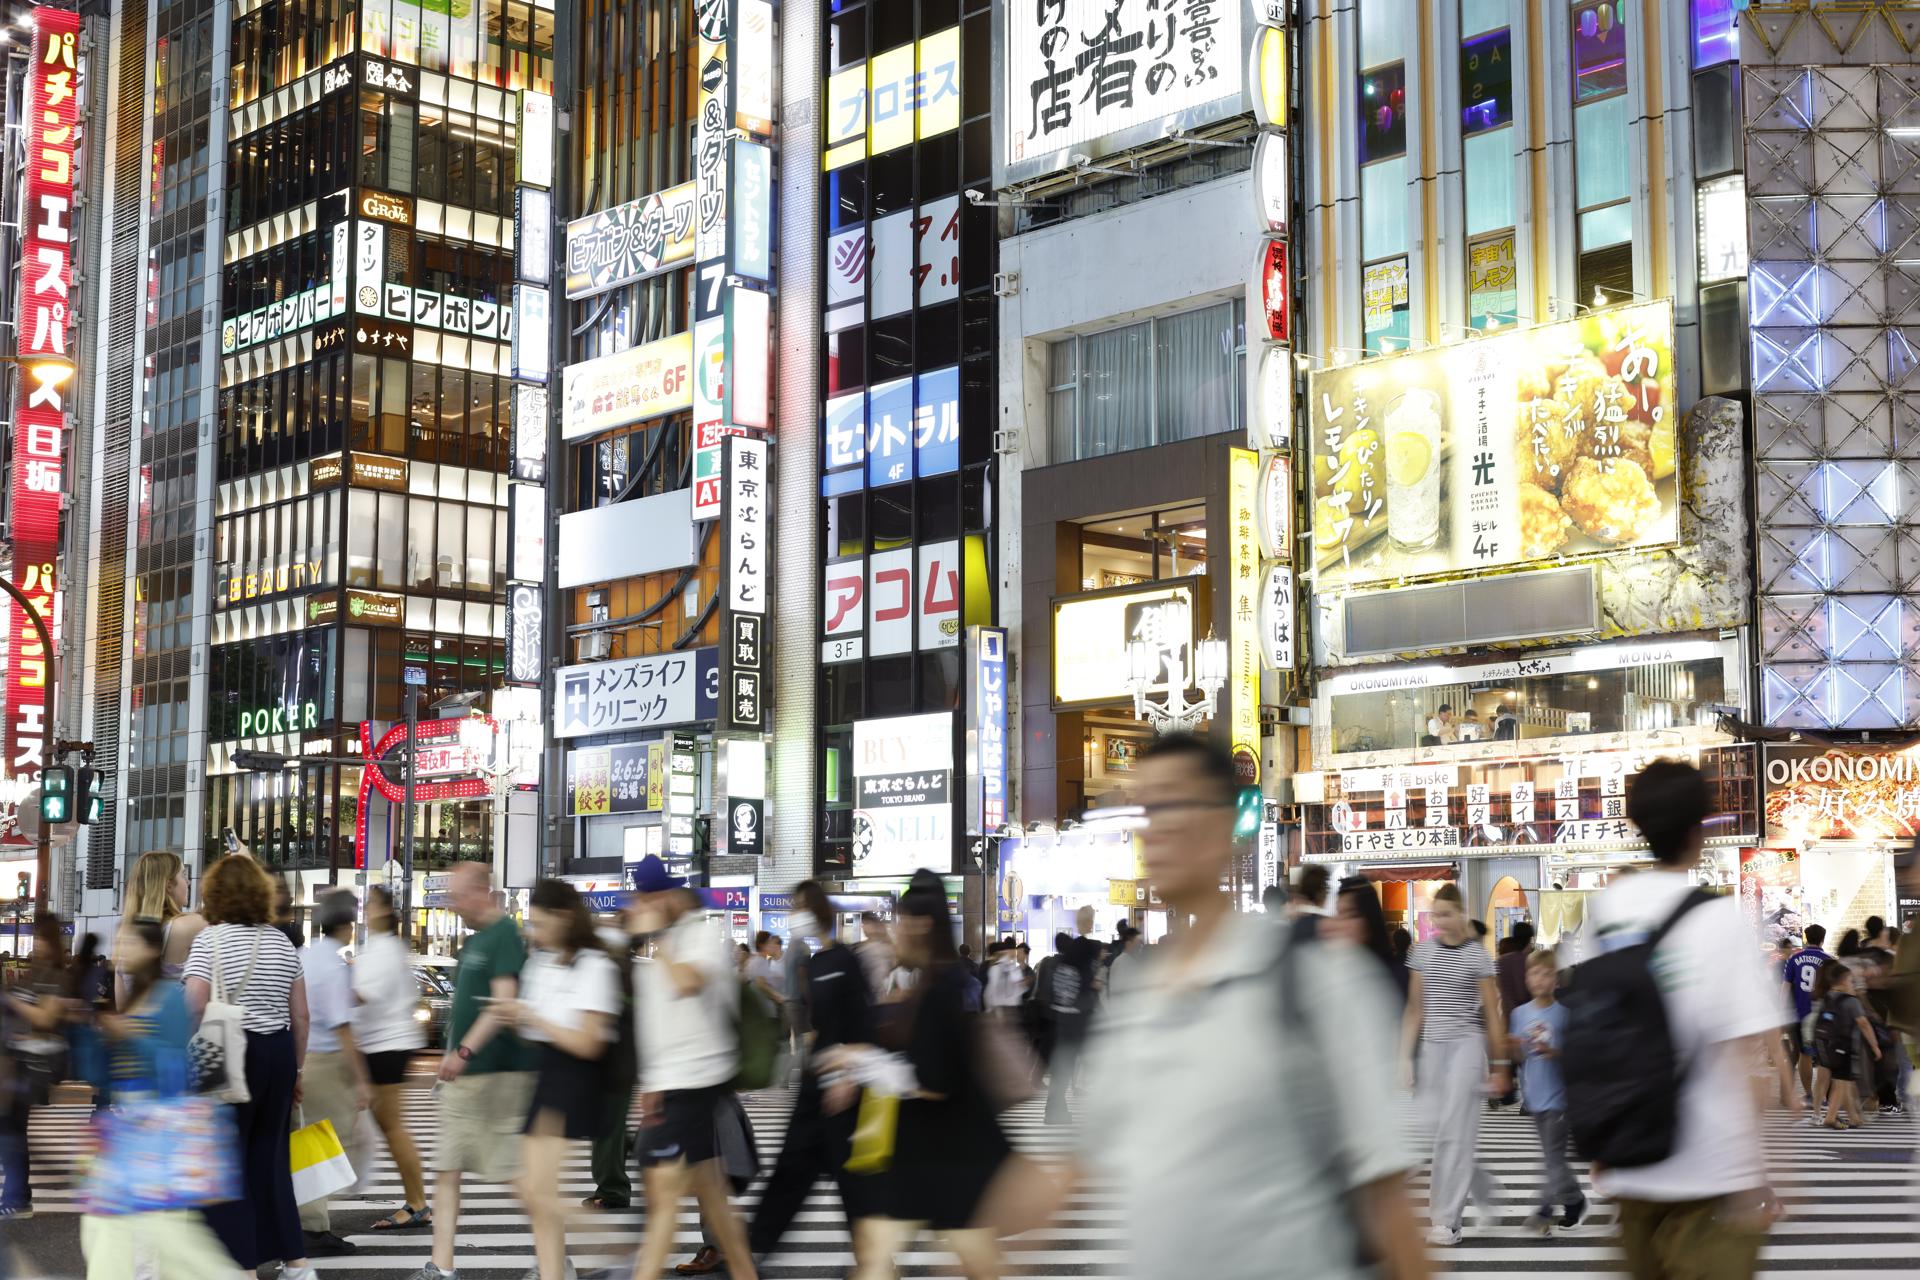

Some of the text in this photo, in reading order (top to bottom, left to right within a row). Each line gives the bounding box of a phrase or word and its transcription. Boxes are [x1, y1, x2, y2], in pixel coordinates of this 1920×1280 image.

[1146, 0, 1176, 95] りの
[40, 31, 77, 184] パチンコ
[840, 60, 959, 135] プロミス
[363, 198, 408, 223] GROVE
[1471, 266, 1515, 292] レモン
[29, 195, 70, 412] エスパス
[238, 292, 329, 347] ビアポンバー
[663, 364, 686, 395] 6F
[827, 400, 959, 465] セントラル
[1477, 387, 1488, 447] チキン酒場
[1593, 381, 1629, 476] 猛烈に
[1273, 436, 1284, 447] 1F
[1527, 395, 1560, 477] たべたい。
[25, 424, 62, 492] 日拓
[519, 459, 543, 480] 7F
[888, 463, 905, 481] 4F
[1472, 452, 1496, 486] 光
[698, 483, 721, 507] AT
[1322, 392, 1353, 569] レモンサワー
[1472, 535, 1498, 560] 4F
[230, 559, 322, 602] BEAUTY
[827, 560, 959, 632] アコム
[1237, 593, 1253, 622] 集
[1273, 587, 1290, 643] かっぱ
[739, 622, 755, 662] 買取
[834, 641, 854, 659] 3F
[1275, 650, 1289, 663] B1
[1618, 649, 1674, 665] MONJA
[593, 659, 687, 696] メンズライフ
[1350, 675, 1429, 691] OKONOMIYAKI
[593, 693, 668, 728] クリニック
[738, 677, 755, 719] 販売
[241, 701, 317, 738] POKER
[983, 666, 1002, 794] じゃんぱら
[863, 735, 912, 765] BUY
[1382, 772, 1412, 788] 新宿
[1565, 759, 1588, 776] 7F
[577, 790, 607, 812] 餃子
[881, 796, 903, 805] TOKYO
[1344, 828, 1458, 850] 6F やきとり本舗
[1566, 824, 1590, 840] 4F
[1794, 956, 1824, 967] BATISTUT
[1801, 965, 1817, 991] 9
